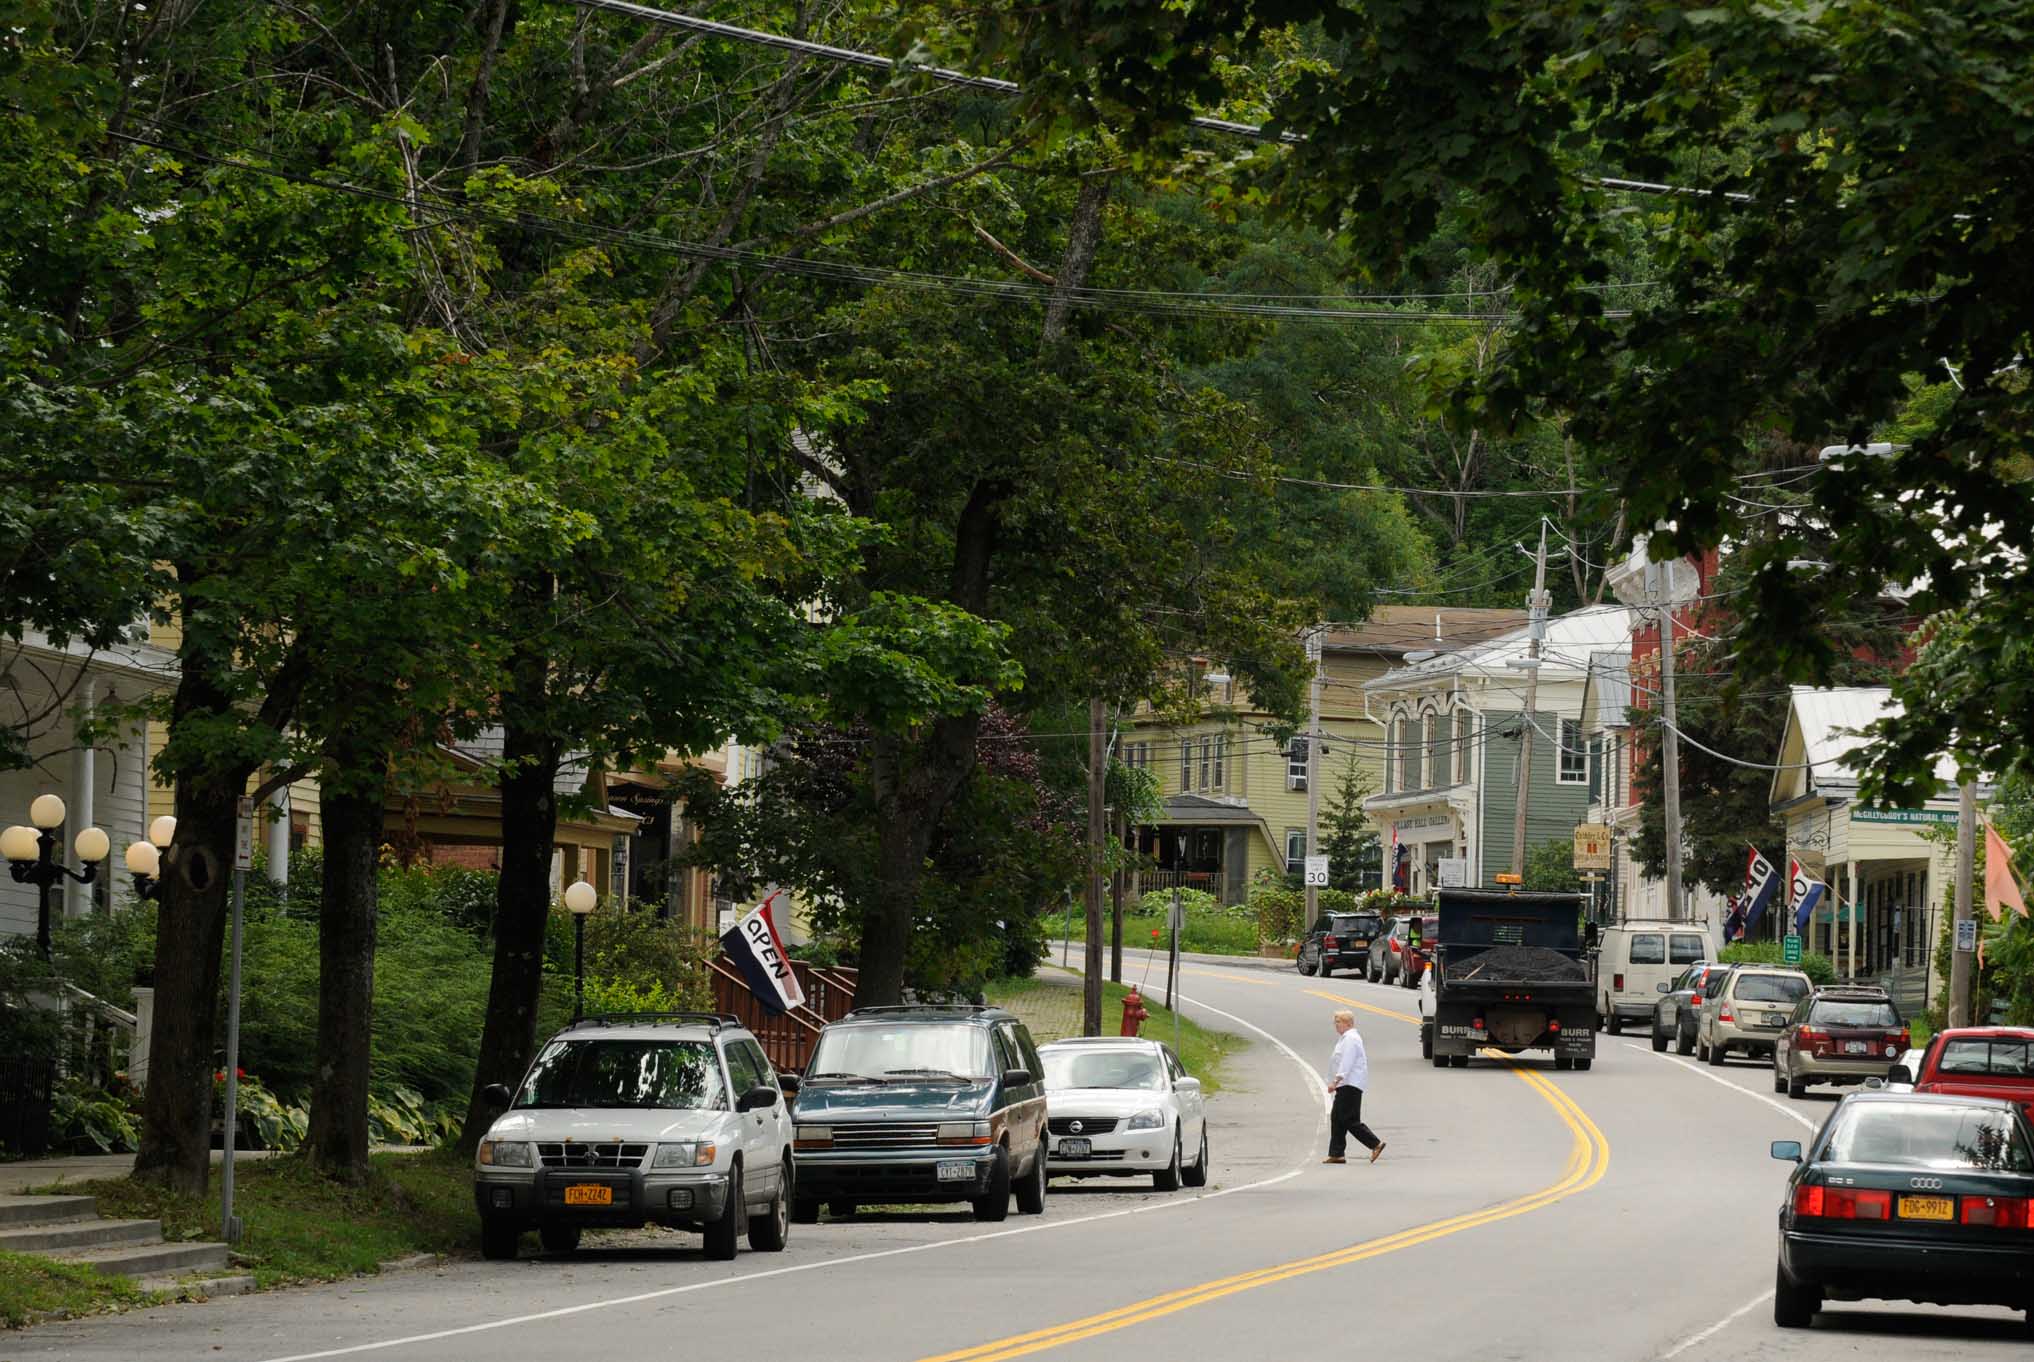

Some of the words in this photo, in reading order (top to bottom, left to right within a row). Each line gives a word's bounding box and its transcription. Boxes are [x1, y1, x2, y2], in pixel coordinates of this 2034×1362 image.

[1910, 813, 1938, 821] NATURAL
[1307, 872, 1327, 883] 30
[747, 919, 790, 980] OPEN
[1561, 1028, 1590, 1037] BURR
